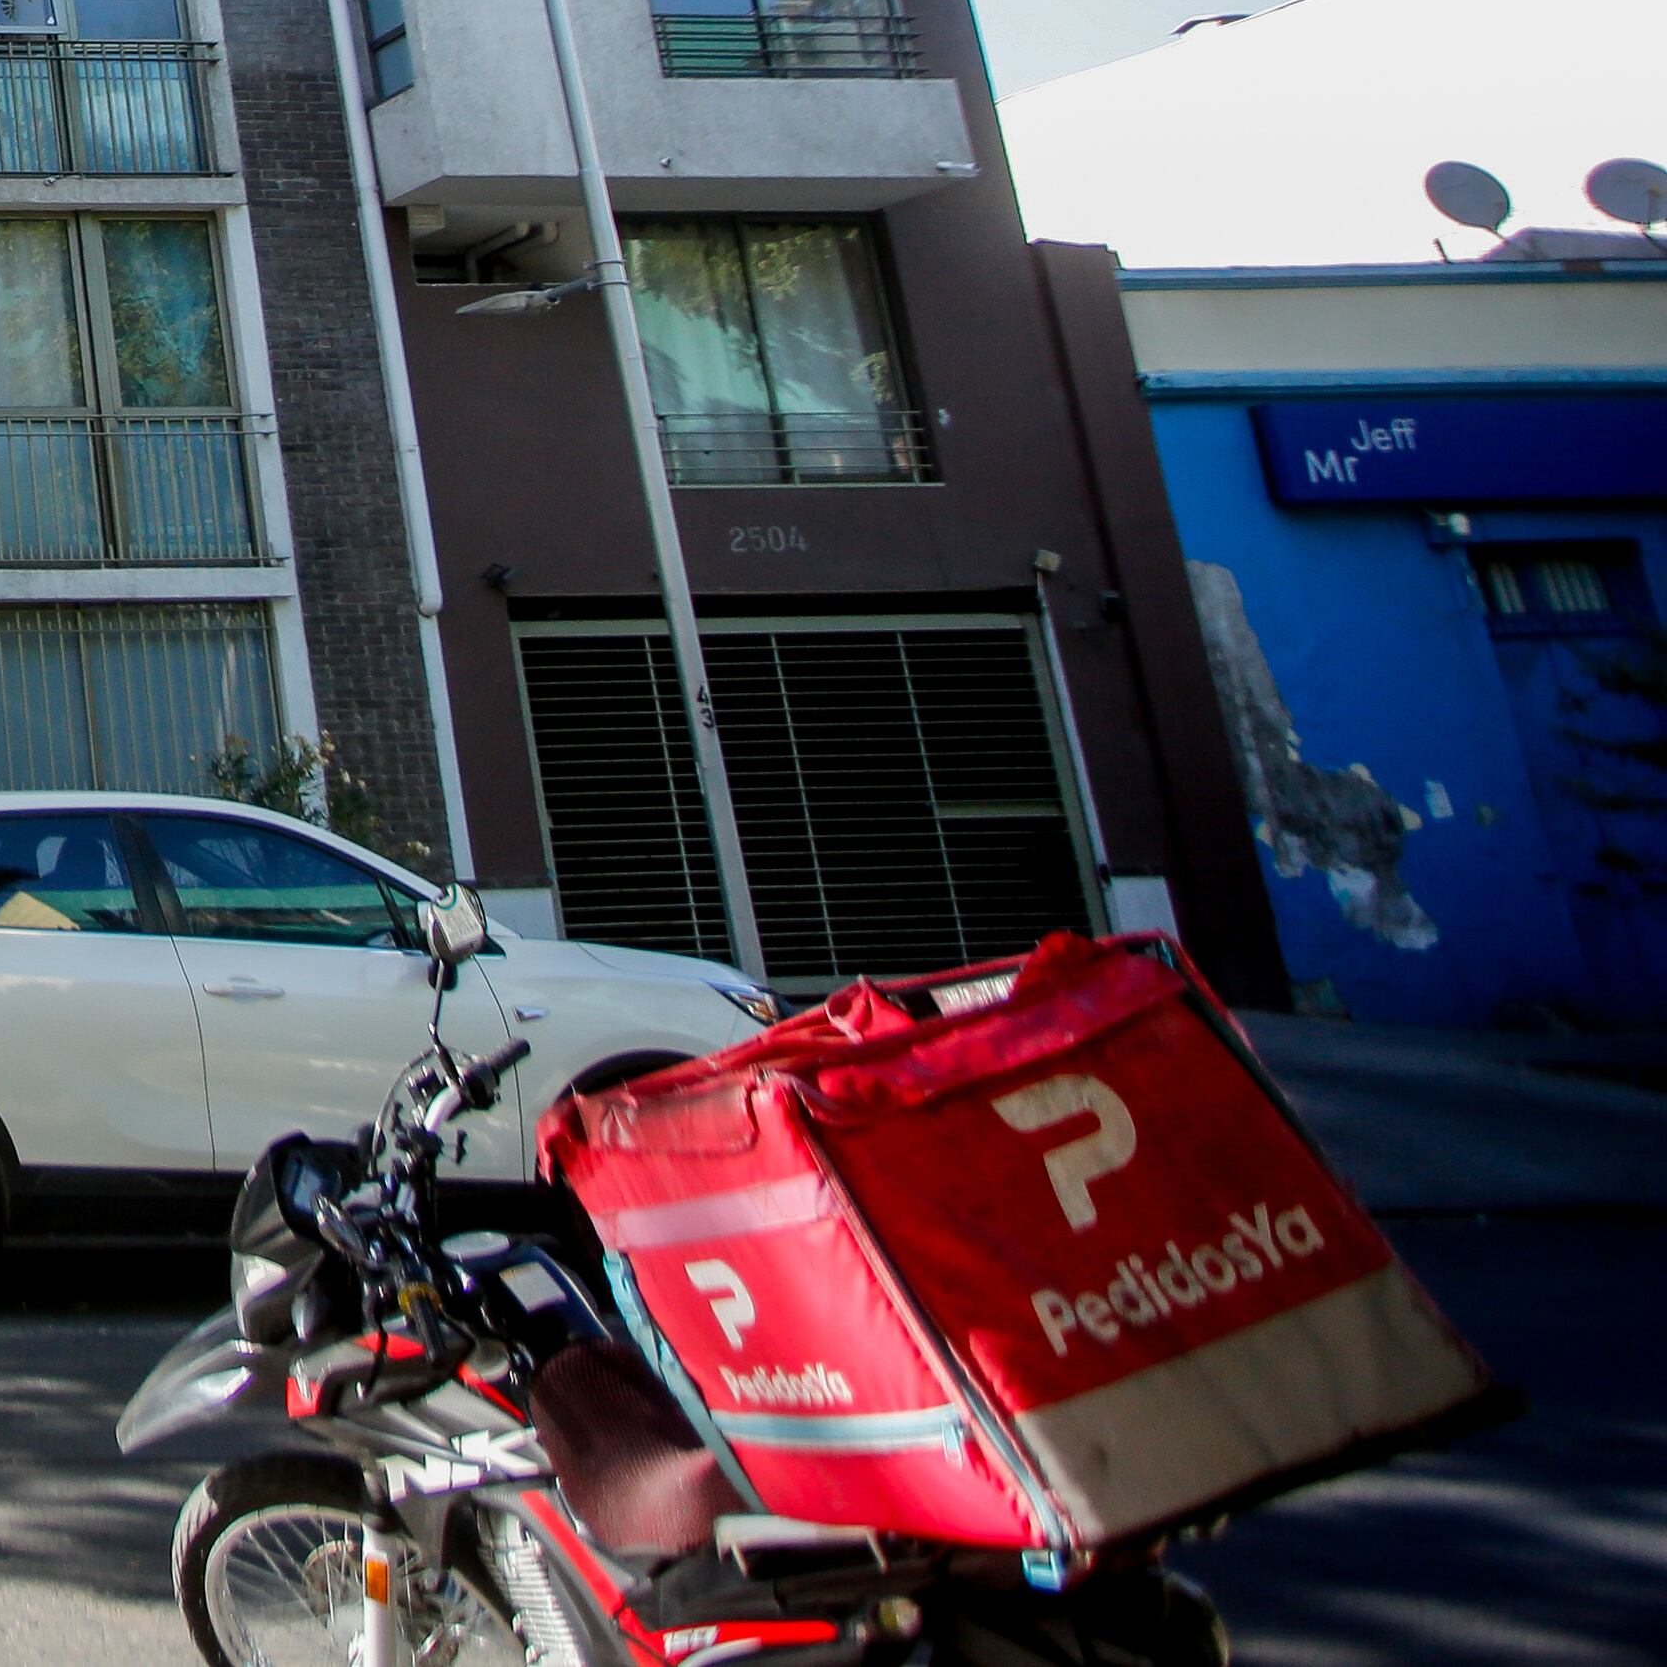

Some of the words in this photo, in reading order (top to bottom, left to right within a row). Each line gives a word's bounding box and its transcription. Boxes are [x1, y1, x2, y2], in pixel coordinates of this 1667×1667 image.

[1305, 449, 1359, 483] Mr
[1351, 418, 1417, 451] Jeff
[729, 526, 809, 551] 2504
[1030, 1202, 1324, 1358] PedidosYa
[717, 1362, 854, 1407] PedidosYa
